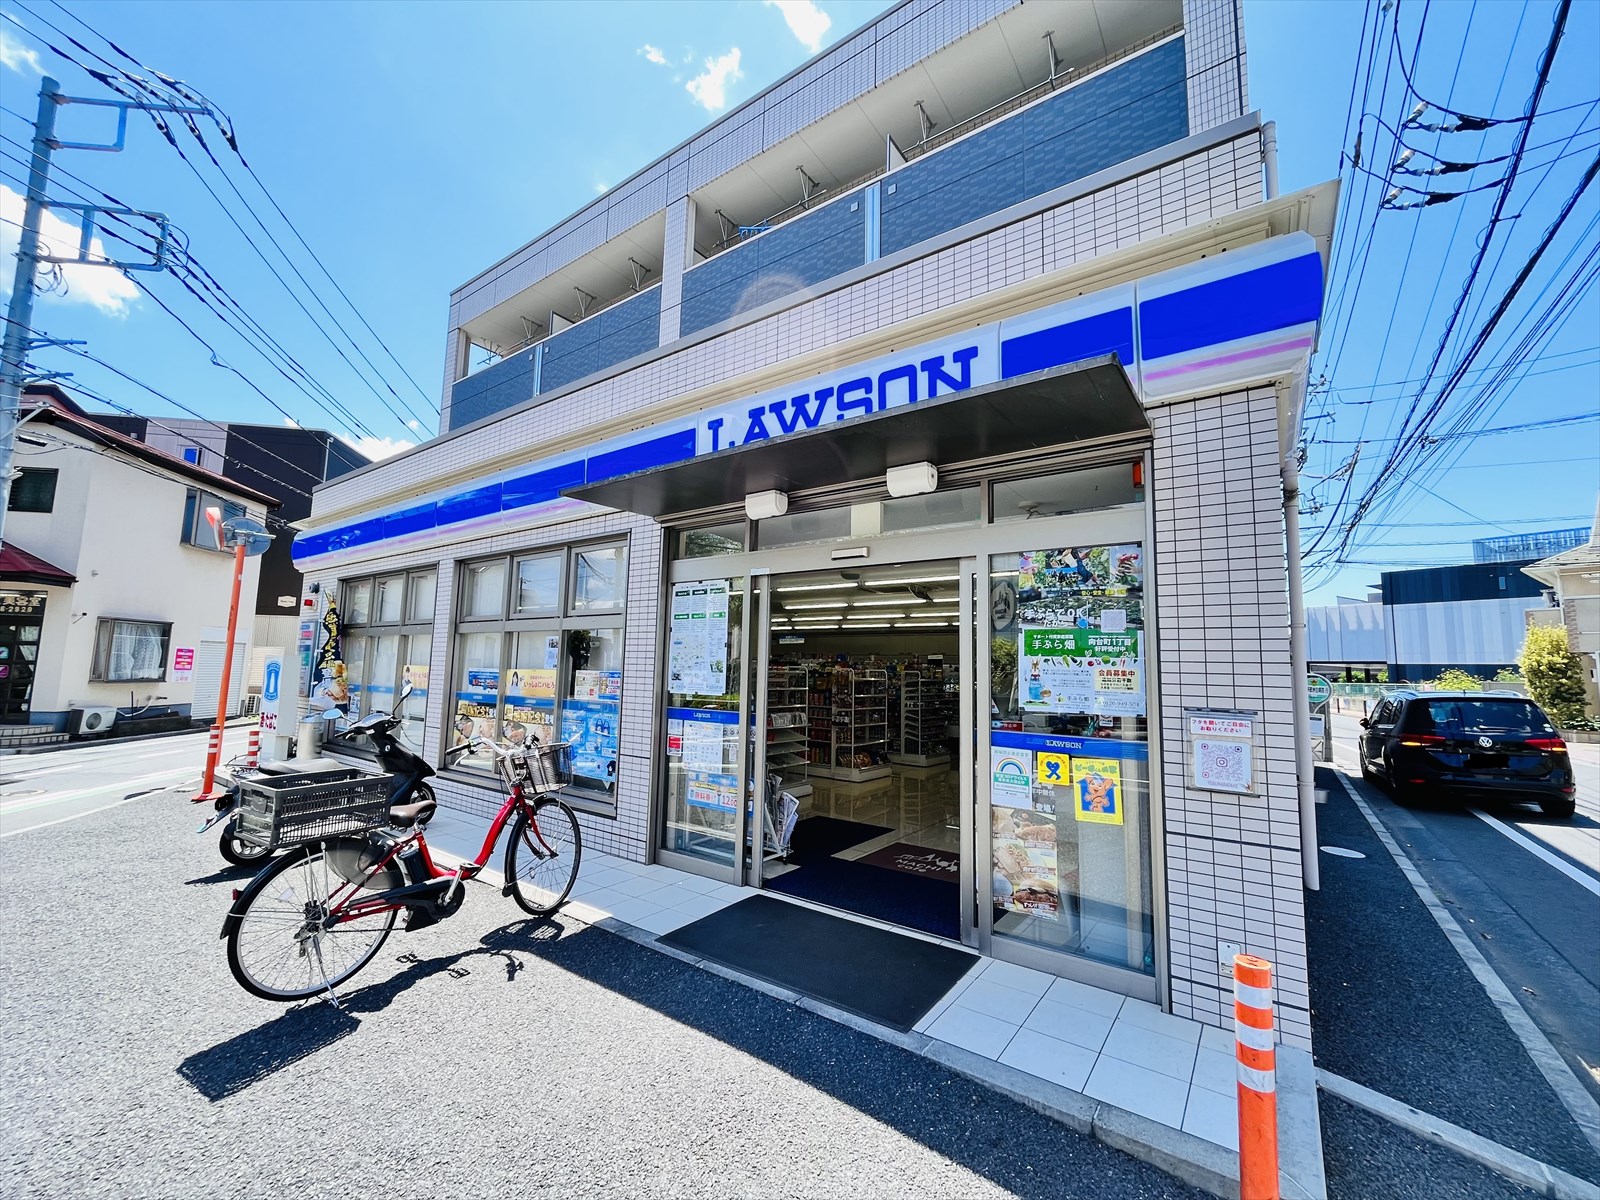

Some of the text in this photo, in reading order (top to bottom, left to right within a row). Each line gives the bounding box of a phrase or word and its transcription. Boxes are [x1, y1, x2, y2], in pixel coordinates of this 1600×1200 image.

[2, 595, 42, 607] 美容室
[1032, 639, 1075, 650] 手ぶら畑
[1088, 638, 1131, 646] 向台町1丁目
[1094, 645, 1126, 653] 好評受付中
[1098, 669, 1136, 678] 会員募集中
[1200, 726, 1242, 734] お取りください
[1044, 739, 1083, 750] LAWSON
